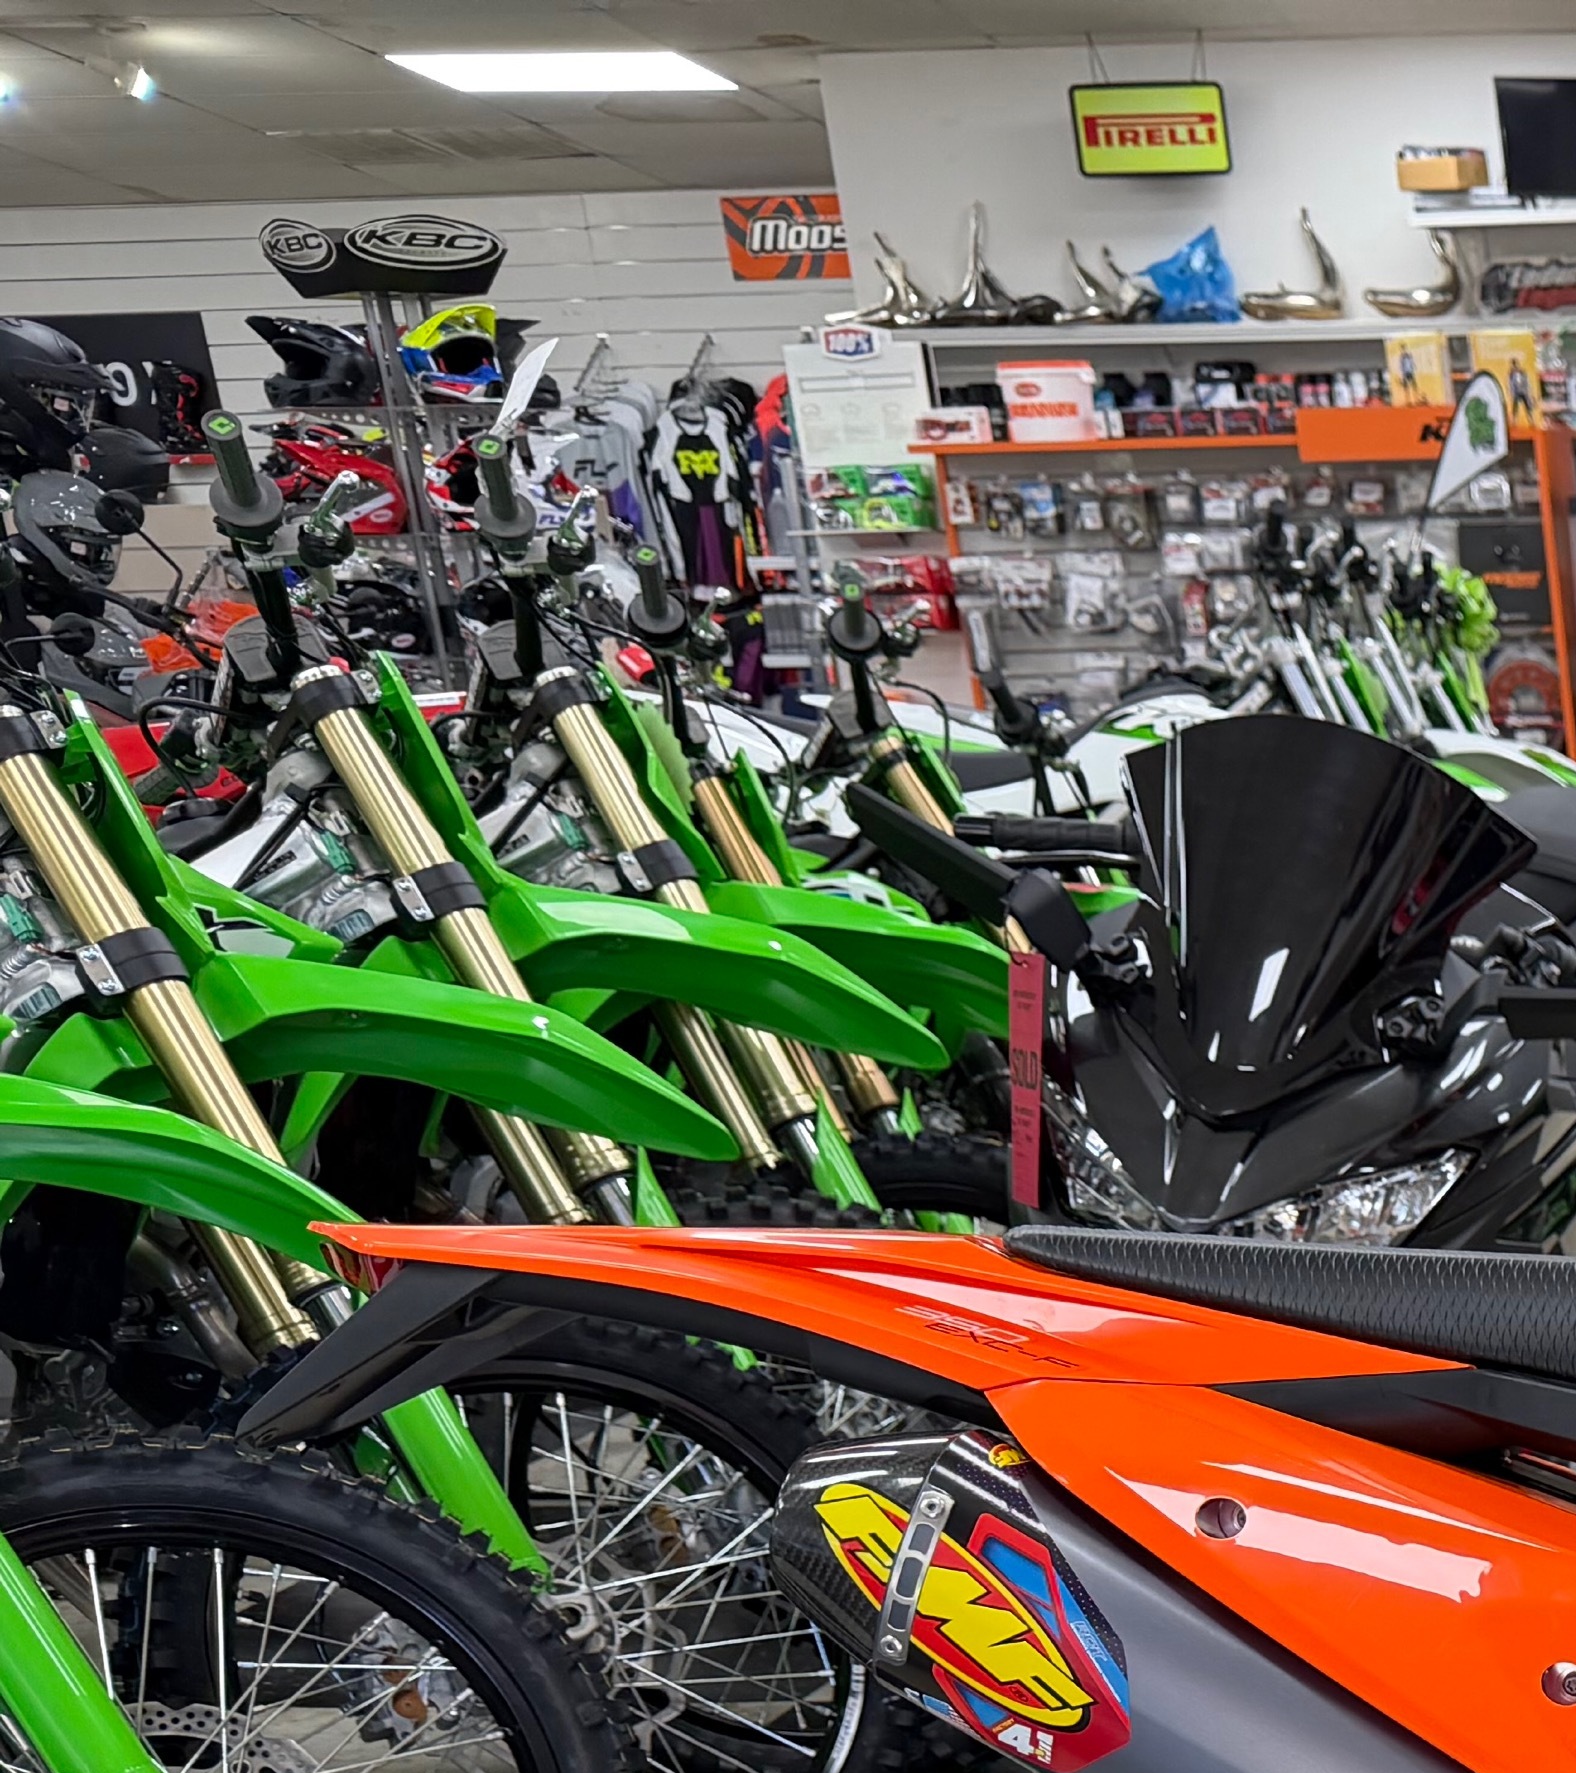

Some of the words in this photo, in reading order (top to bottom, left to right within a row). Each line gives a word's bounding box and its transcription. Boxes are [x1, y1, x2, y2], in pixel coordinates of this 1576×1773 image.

[1083, 113, 1217, 148] PIRELLI
[266, 232, 324, 256] KBC
[361, 229, 488, 250] KBC
[573, 459, 620, 480] FLY
[1010, 1047, 1039, 1091] SOLD
[813, 1492, 1098, 1712] FMF
